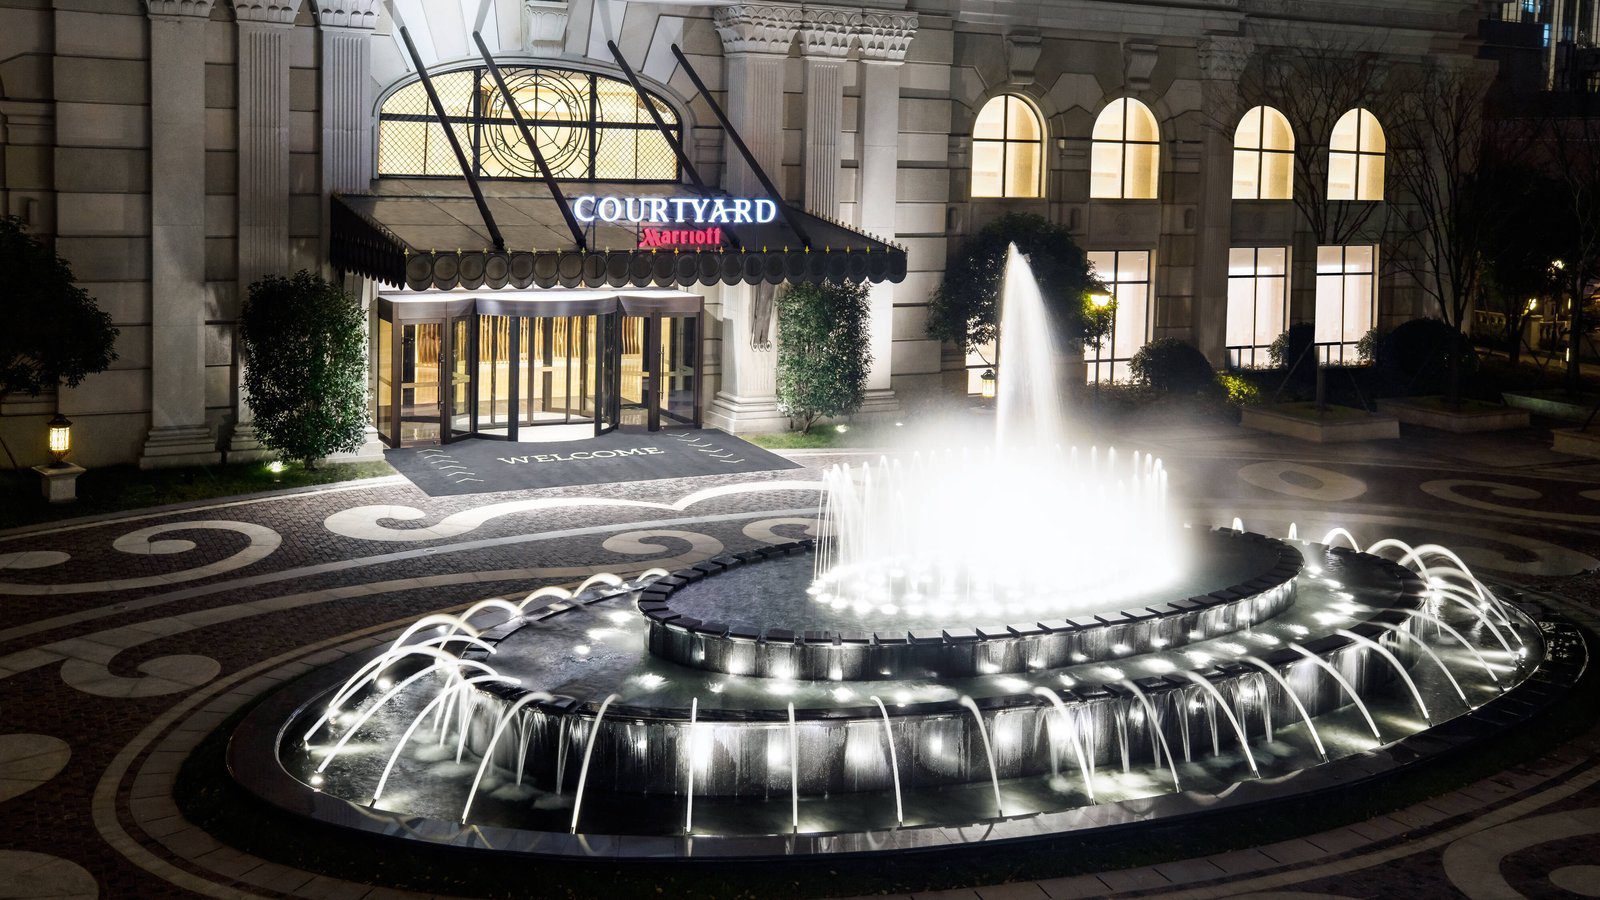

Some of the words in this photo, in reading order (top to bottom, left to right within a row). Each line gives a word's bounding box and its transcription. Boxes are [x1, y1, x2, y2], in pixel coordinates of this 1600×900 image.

[574, 196, 776, 223] COURTYARD
[639, 227, 720, 247] Marriott
[498, 447, 664, 465] WELCOME
